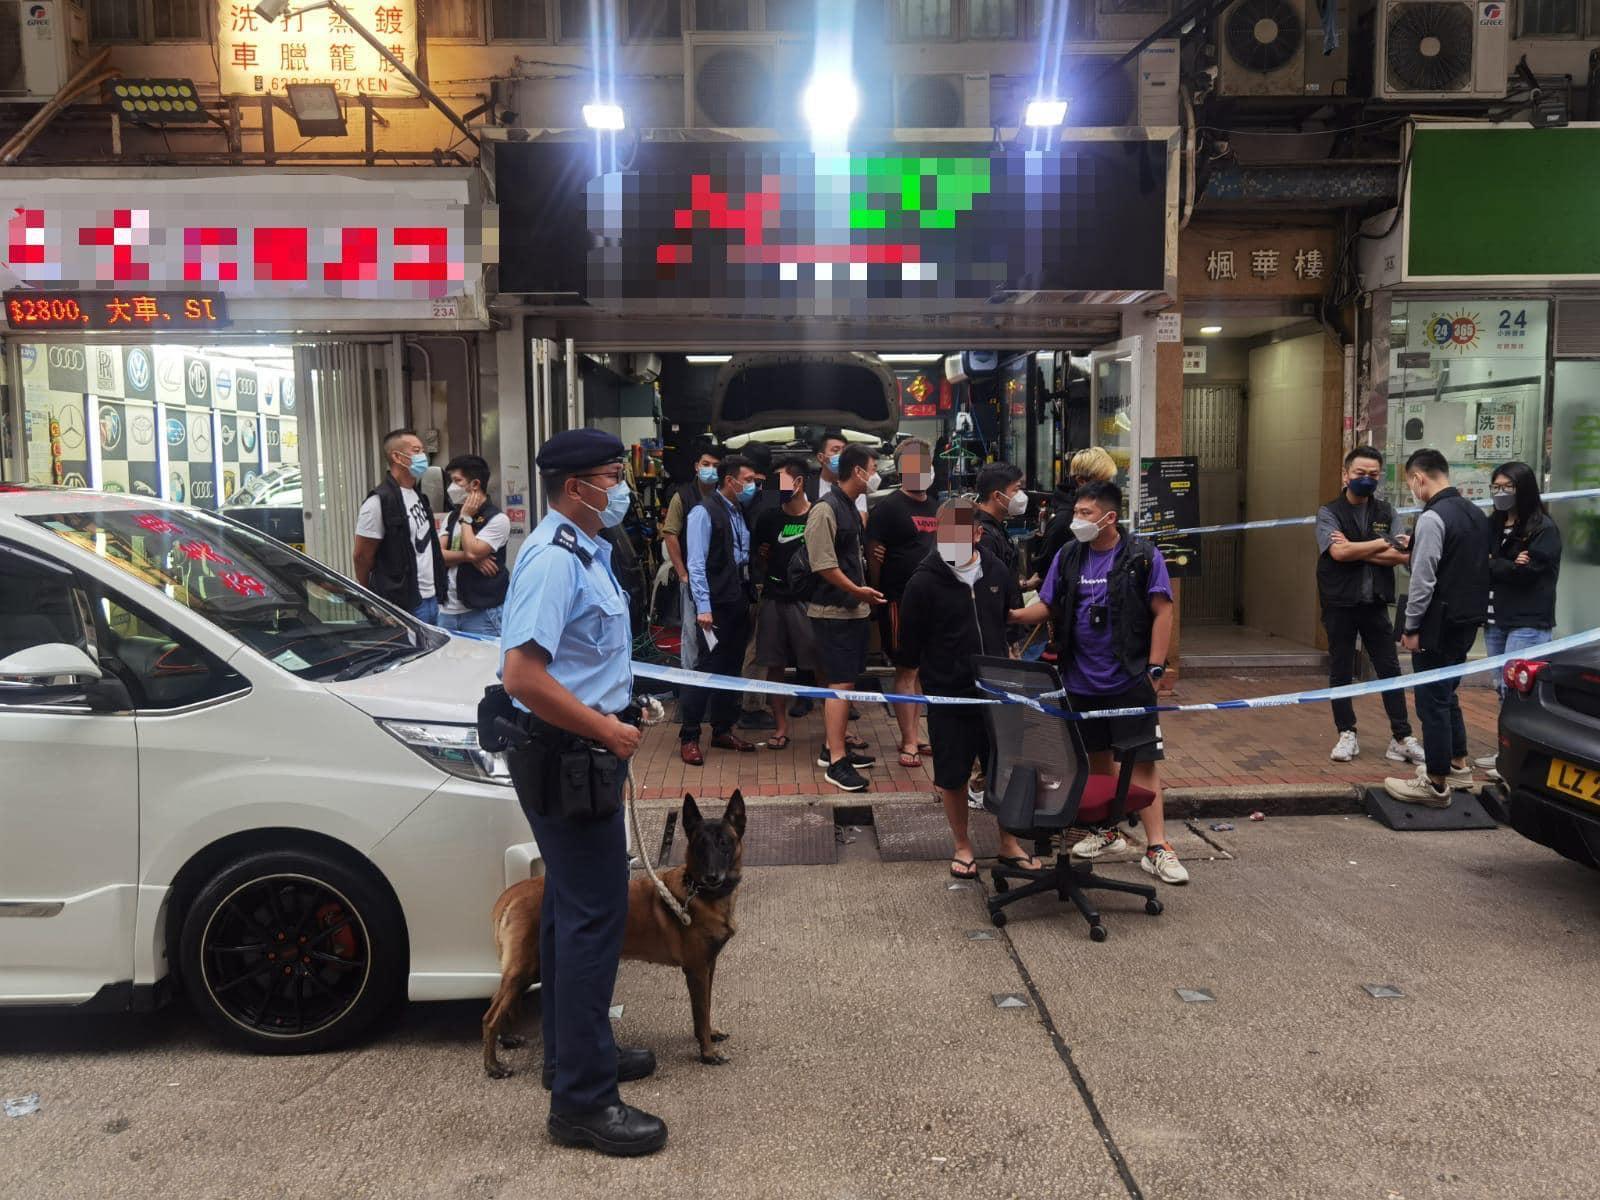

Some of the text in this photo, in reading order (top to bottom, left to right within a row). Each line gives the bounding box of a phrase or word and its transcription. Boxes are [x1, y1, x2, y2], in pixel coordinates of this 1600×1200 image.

[357, 78, 388, 92] KEN
[1207, 249, 1325, 280] 楓華樓
[433, 308, 456, 317] 23A
[1499, 310, 1527, 329] 24
[1434, 324, 1474, 337] 24 365
[1480, 415, 1495, 431] 洗
[783, 524, 805, 537] NIKE
[1559, 764, 1587, 794] LZ
